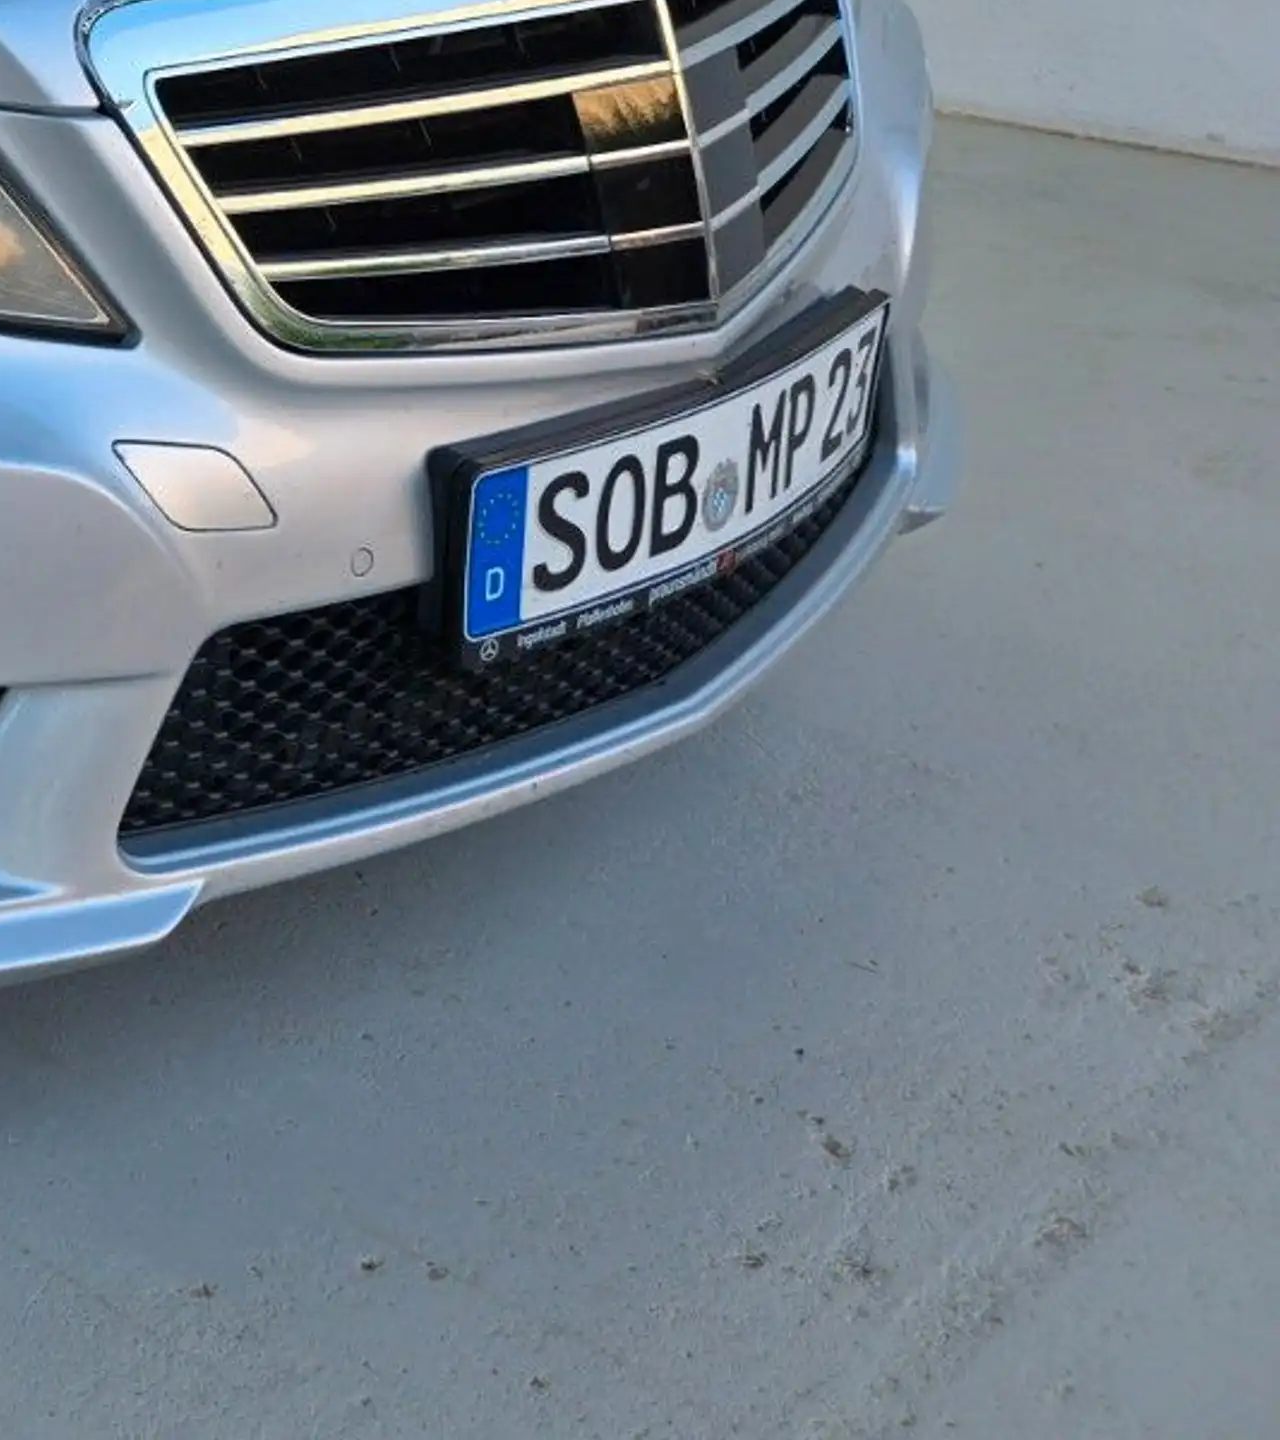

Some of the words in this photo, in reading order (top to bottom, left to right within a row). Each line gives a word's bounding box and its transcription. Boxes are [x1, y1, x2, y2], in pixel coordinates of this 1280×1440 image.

[532, 433, 701, 592] SOB
[745, 373, 816, 515] MP
[485, 566, 505, 602] D
